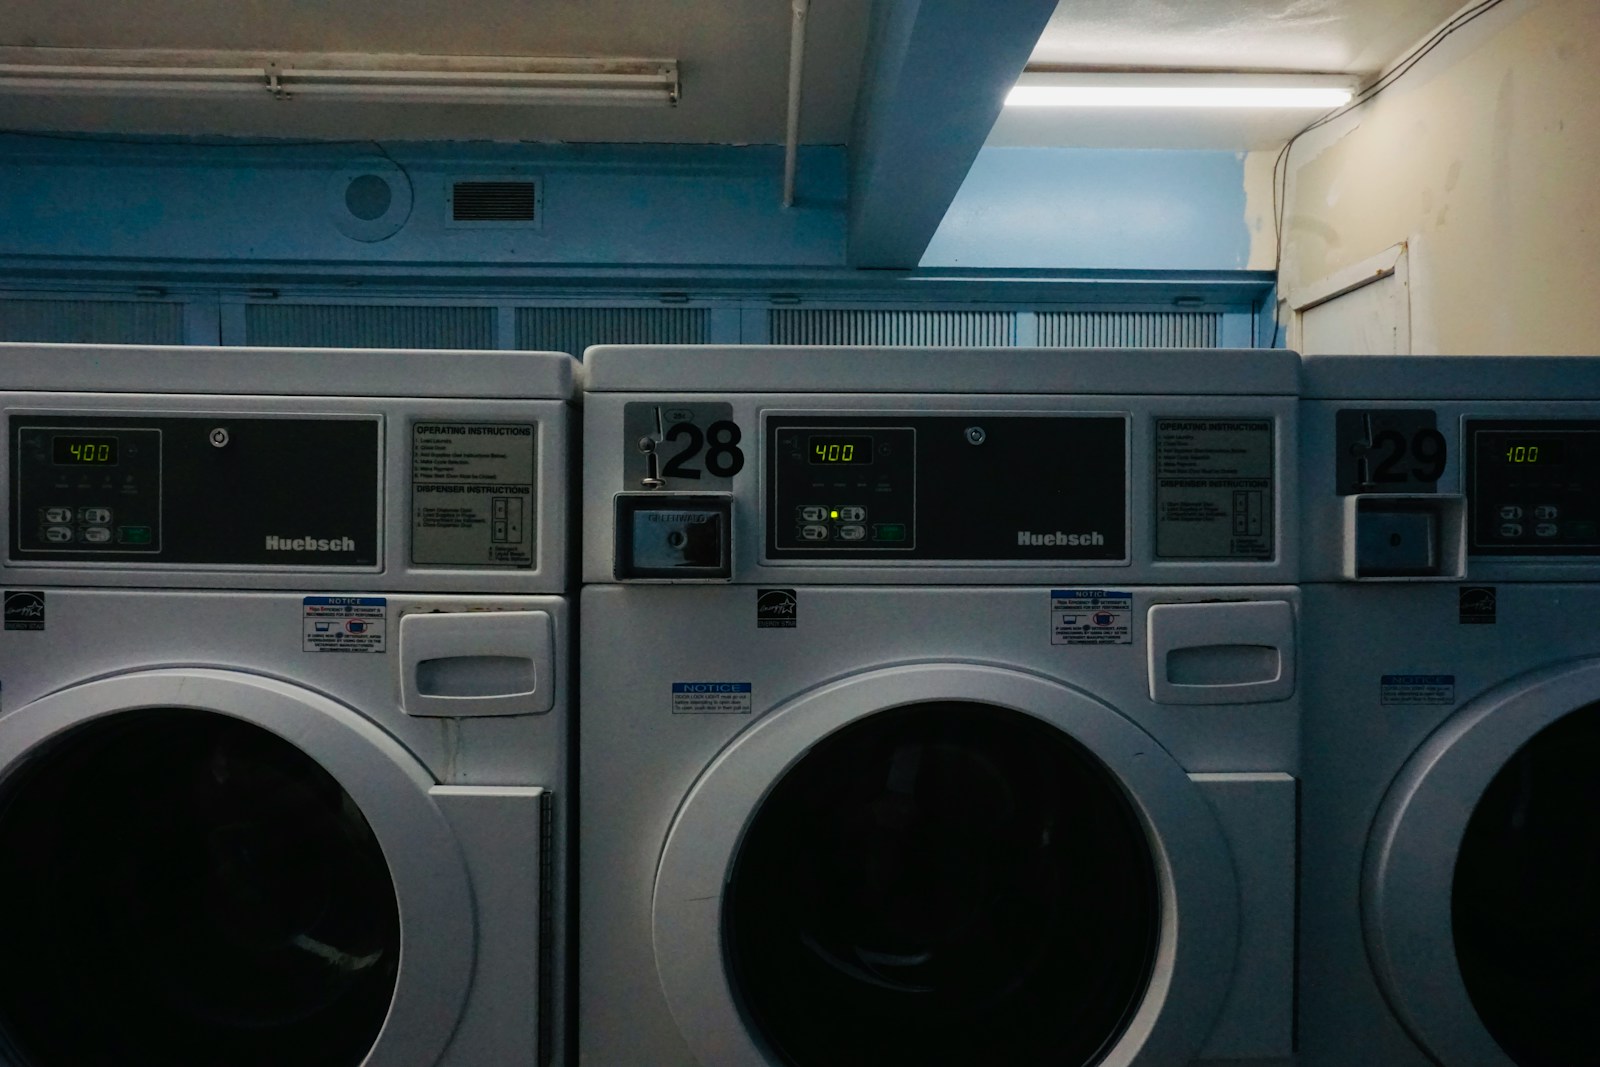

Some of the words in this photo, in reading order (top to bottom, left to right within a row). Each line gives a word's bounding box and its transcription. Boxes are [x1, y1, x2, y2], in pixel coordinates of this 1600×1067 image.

[417, 426, 466, 435] OPERATING
[468, 426, 531, 436] INSTRUCTIONS
[1159, 423, 1207, 431] OPERATING
[1208, 423, 1269, 431] INSTRUCTIONS
[70, 444, 110, 461] 400
[662, 420, 744, 480] 28
[815, 444, 854, 461] 400
[1372, 428, 1447, 483] 29
[417, 485, 465, 493] DISPENSER
[467, 486, 530, 494] INSTRUCTIONS
[1160, 480, 1207, 488] DISPENSER
[1208, 480, 1268, 488] INSTRUCTIONS
[265, 535, 355, 551] Huebsch
[1017, 531, 1104, 546] Huebsch
[684, 684, 741, 692] NOTICE
